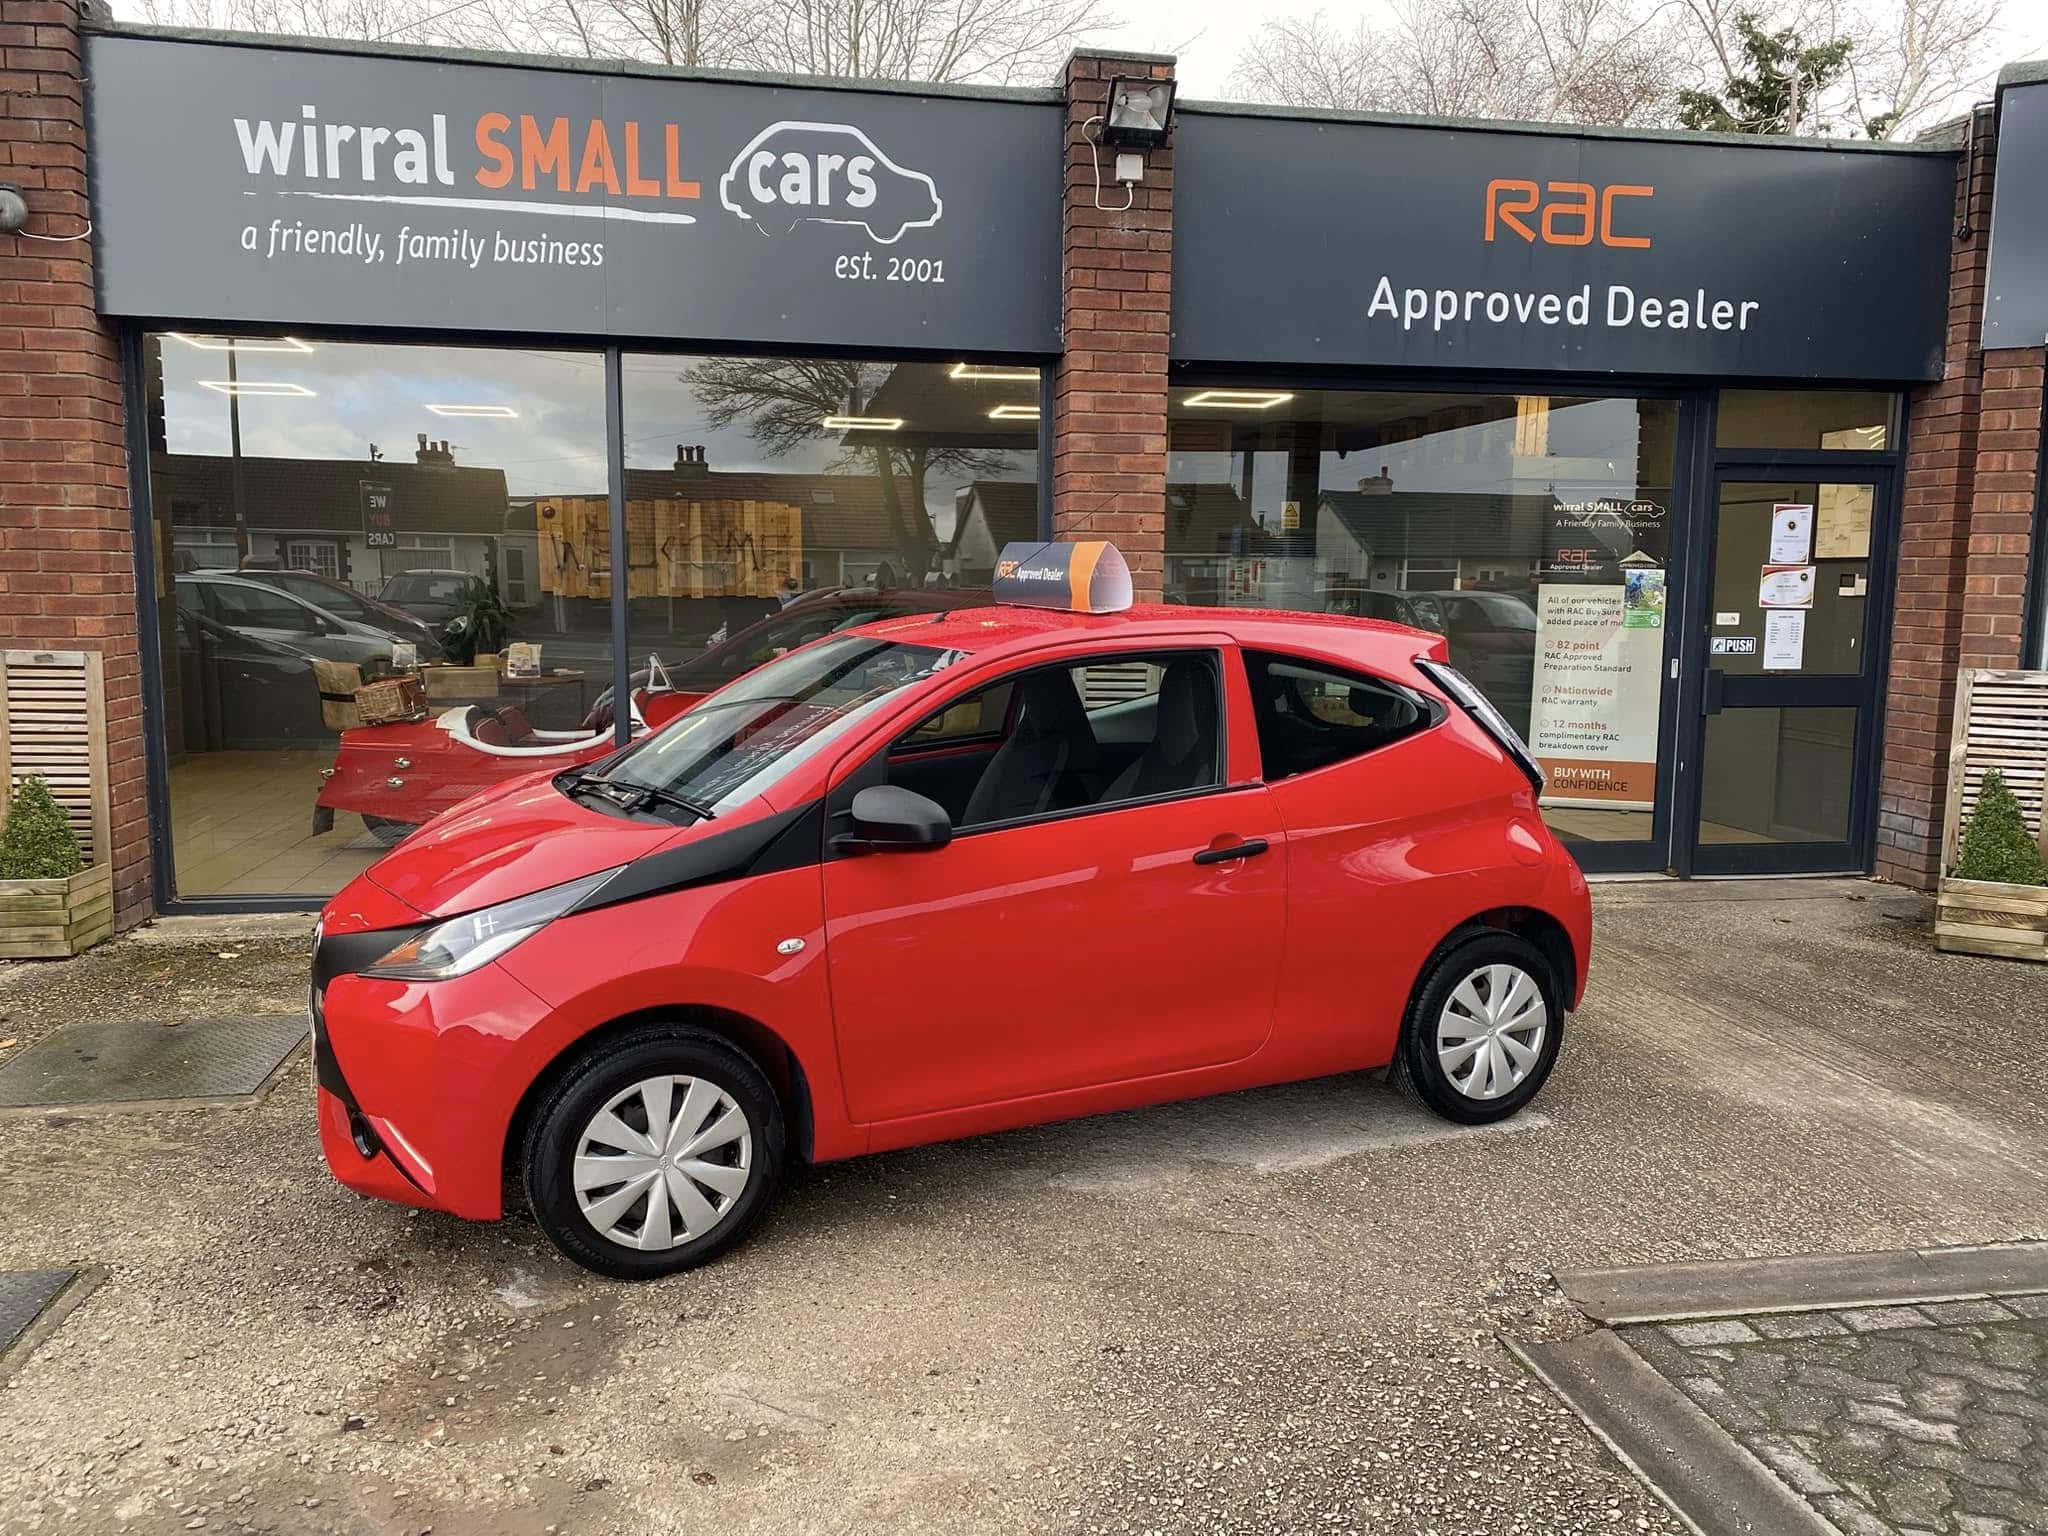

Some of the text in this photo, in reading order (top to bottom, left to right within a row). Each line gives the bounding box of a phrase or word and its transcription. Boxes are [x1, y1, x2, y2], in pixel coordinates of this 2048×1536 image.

[233, 104, 877, 208] wirral SMALL cars
[240, 219, 604, 269] a friendly, family business
[835, 251, 945, 283] est. 2001
[1367, 275, 1760, 331] Approved Dealer
[1586, 502, 1624, 512] SMALL
[1631, 503, 1653, 512] cars
[1567, 607, 1584, 615] RAC
[1557, 640, 1600, 651] 82 point
[1726, 640, 1754, 653] PUSH
[1544, 652, 1602, 661] RAC Approved
[1543, 663, 1632, 673] Preparation Standard
[1554, 685, 1613, 696] Nationwide
[1541, 697, 1598, 707] RAC warranty
[1553, 720, 1607, 731] 12 months
[1539, 732, 1620, 742] complimentary RAC
[1538, 742, 1584, 751] breakdown
[1554, 767, 1611, 780] BUY WITH
[1553, 778, 1629, 792] CONFIDENCE
